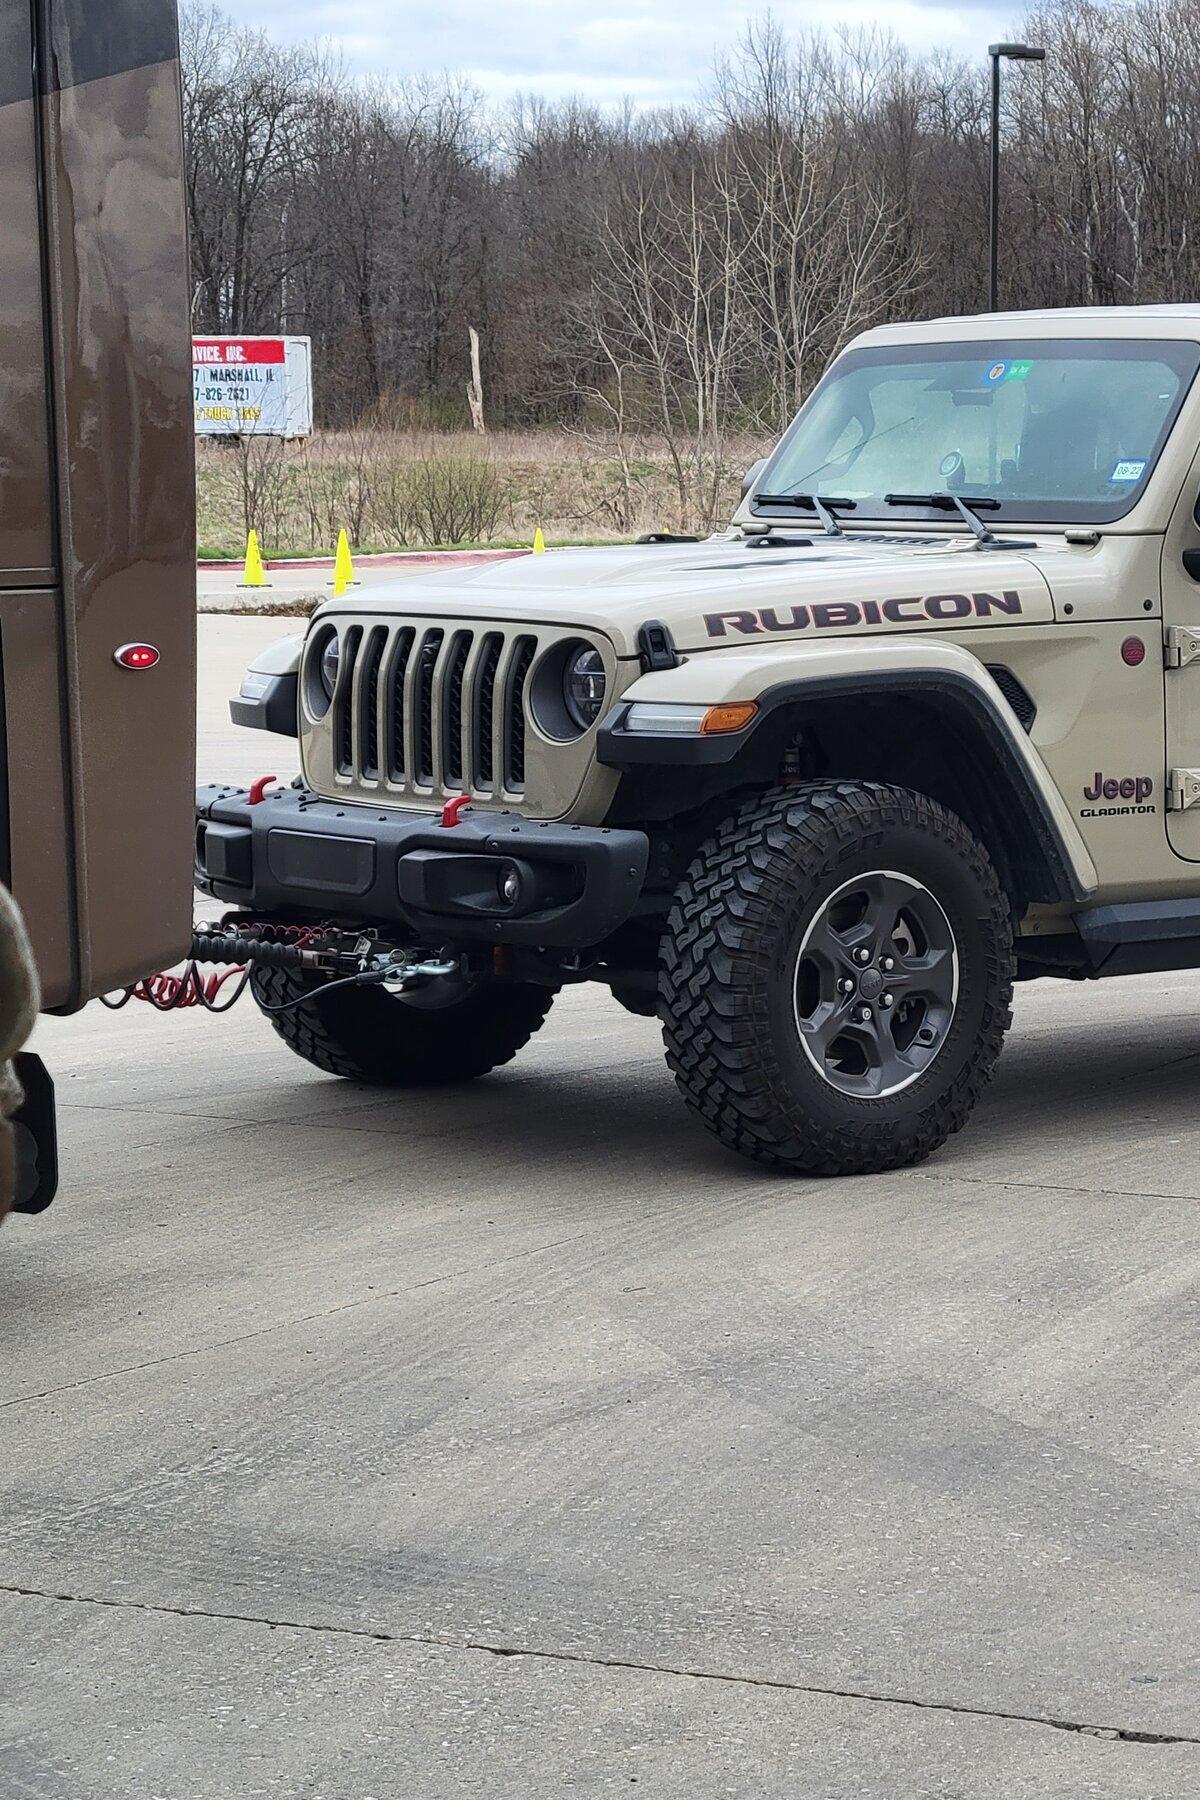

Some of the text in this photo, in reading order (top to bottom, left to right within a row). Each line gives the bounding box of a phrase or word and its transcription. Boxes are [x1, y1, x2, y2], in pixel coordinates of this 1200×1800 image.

[210, 369, 262, 382] MARSHALL,
[702, 590, 1023, 637] RUBICON
[1083, 772, 1153, 804] Jeep
[1080, 805, 1156, 817] GLADIATOR
